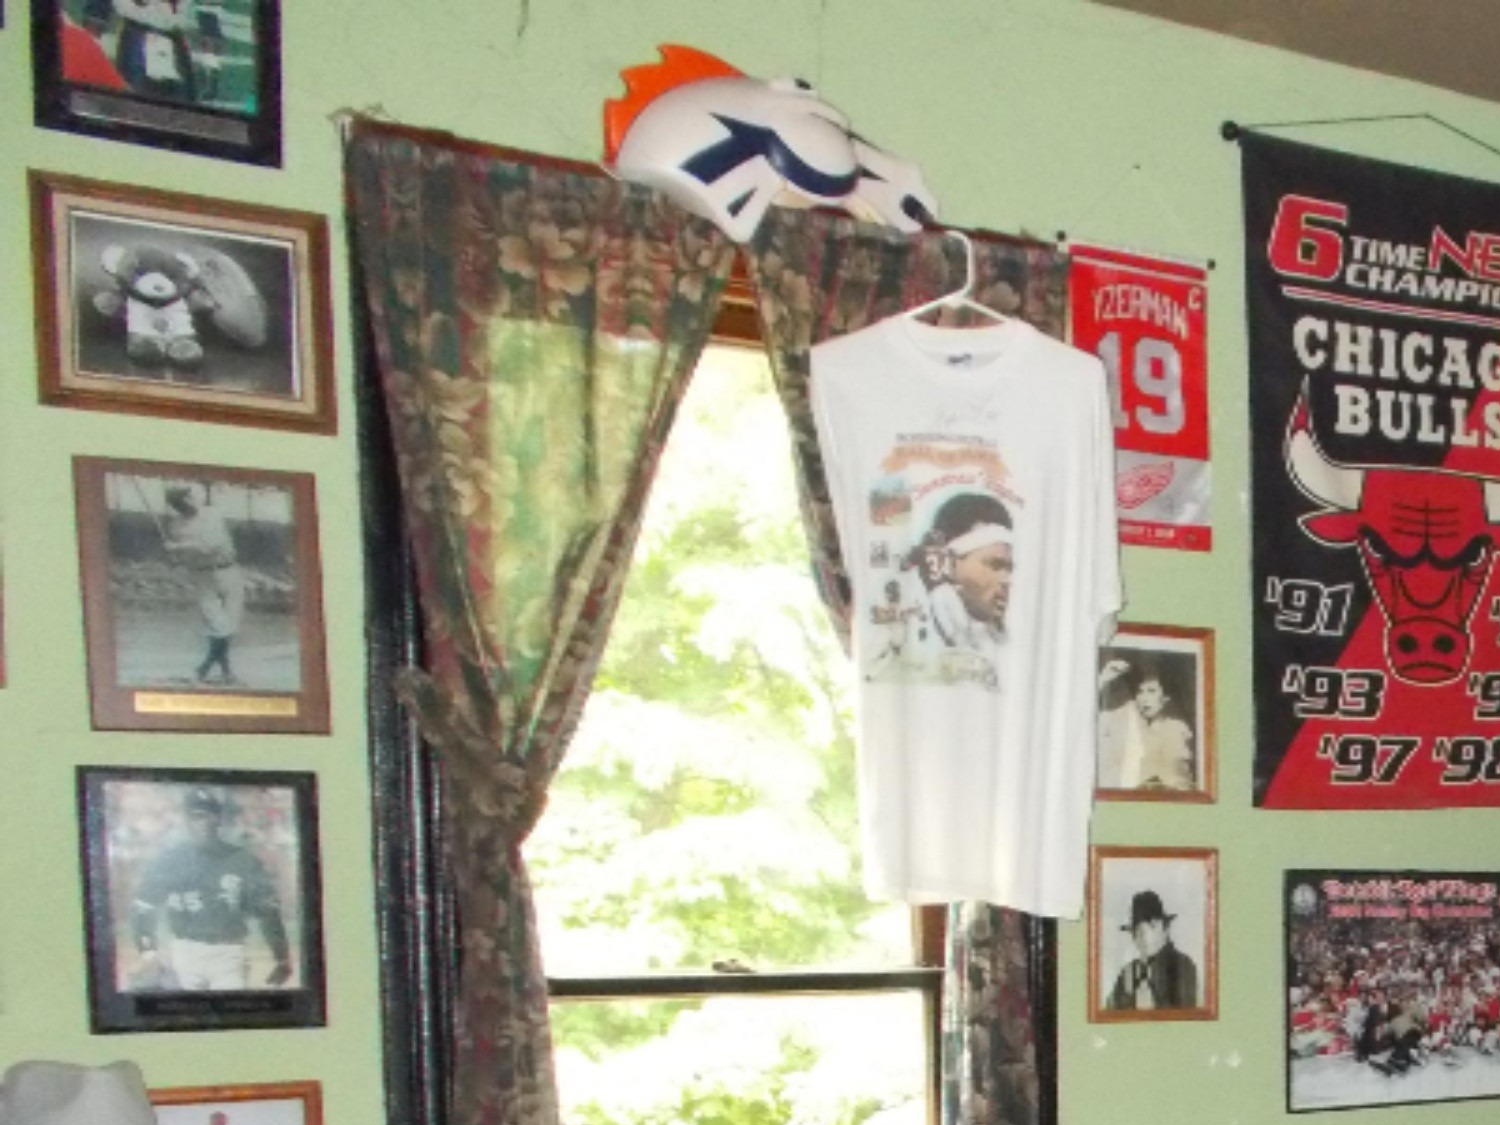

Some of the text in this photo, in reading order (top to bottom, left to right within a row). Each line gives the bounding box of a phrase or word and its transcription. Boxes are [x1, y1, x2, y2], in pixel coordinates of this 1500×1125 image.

[1267, 194, 1348, 282] 6
[1350, 235, 1426, 270] TIME
[1092, 283, 1188, 340] YZERMAN
[1095, 330, 1186, 434] 19
[1264, 575, 1353, 636] '91
[1281, 664, 1388, 721] '93
[1315, 734, 1422, 786] '97
